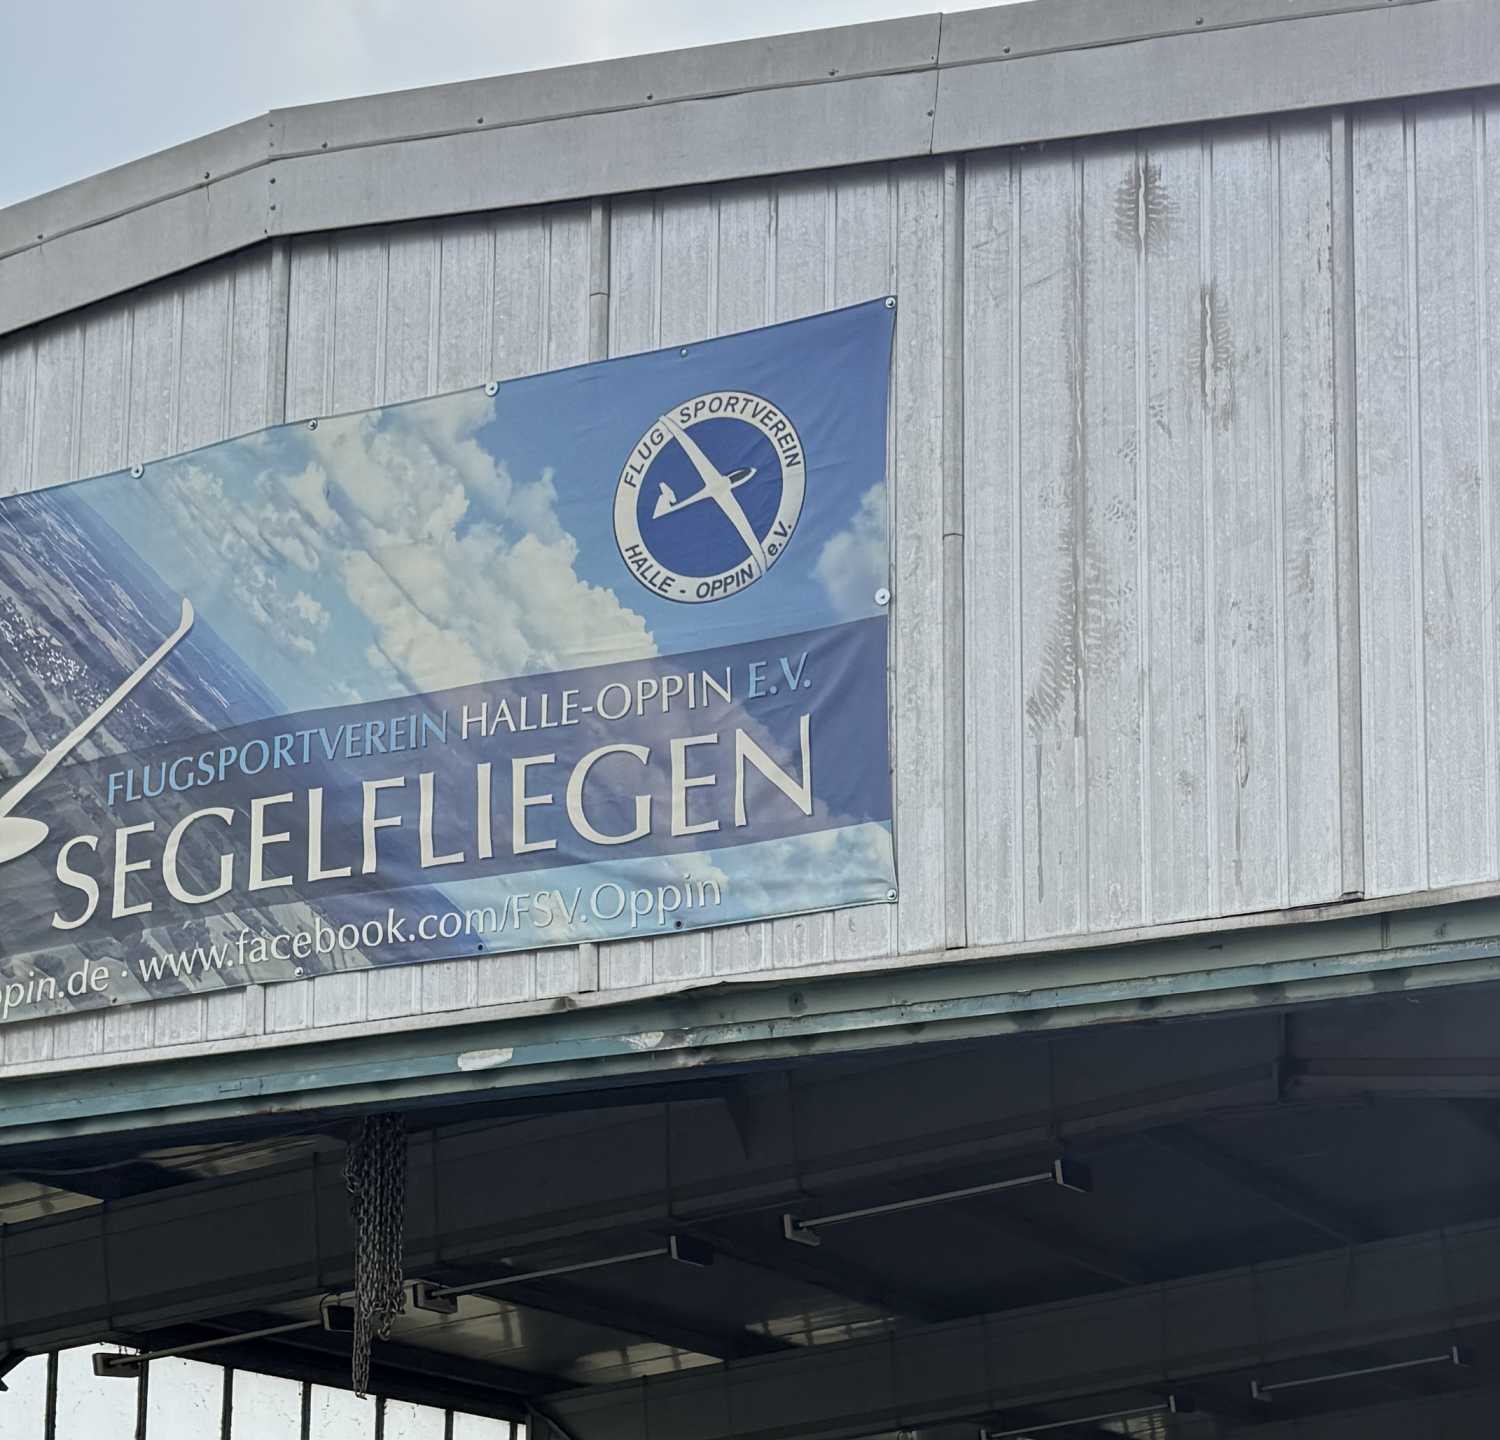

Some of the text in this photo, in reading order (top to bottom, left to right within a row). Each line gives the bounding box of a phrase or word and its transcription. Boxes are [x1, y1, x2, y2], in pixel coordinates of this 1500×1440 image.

[624, 396, 801, 488] FLUG SPORTVEREIN
[625, 544, 676, 593] HALLE
[696, 564, 754, 599] OPPIN
[767, 520, 792, 557] e.V.
[106, 652, 813, 806] FLUGSPORTVEREIN HALLE-OPPIN E.V.
[51, 713, 813, 931] SEGELFLIEGEN
[0, 873, 722, 1019] pin.de www.facebook.com/FSV.Oppin
